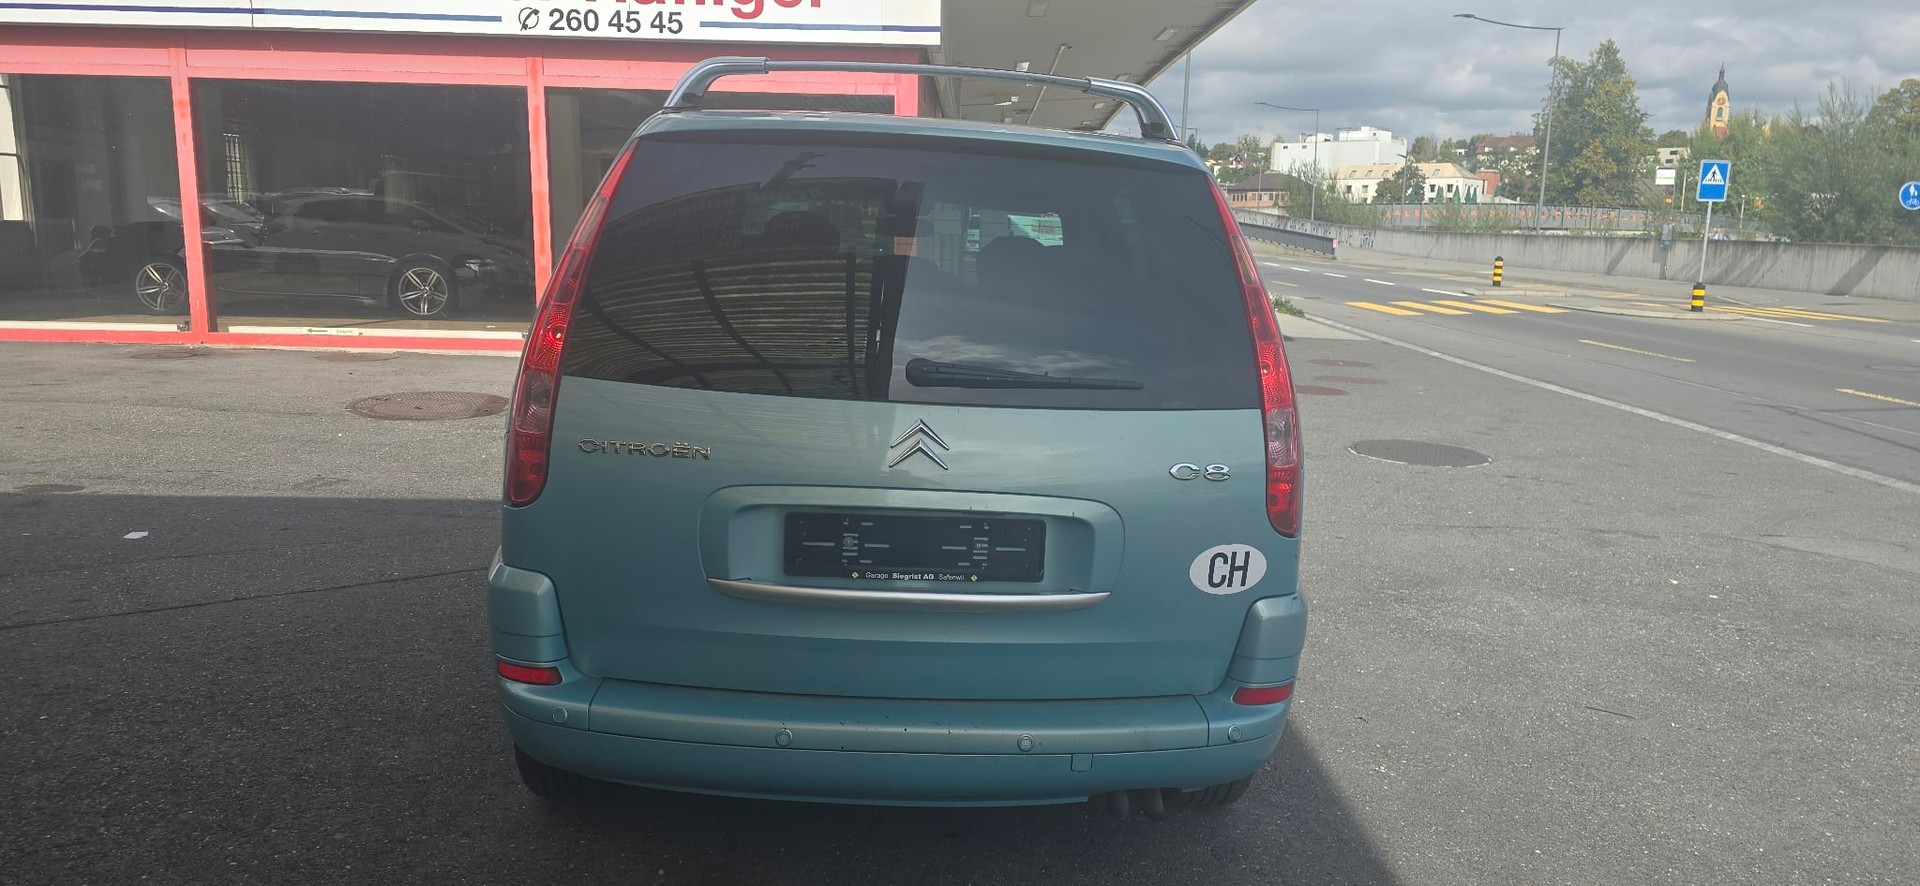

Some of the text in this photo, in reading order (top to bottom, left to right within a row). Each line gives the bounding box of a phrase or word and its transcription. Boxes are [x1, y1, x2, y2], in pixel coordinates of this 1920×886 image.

[549, 8, 600, 32] 260
[608, 10, 642, 34] 45
[650, 11, 683, 34] 45
[578, 437, 712, 460] CITROËN
[1169, 463, 1231, 482] C8
[865, 571, 888, 580] Garage
[892, 572, 922, 580] Siegrist
[1208, 551, 1250, 588] CH
